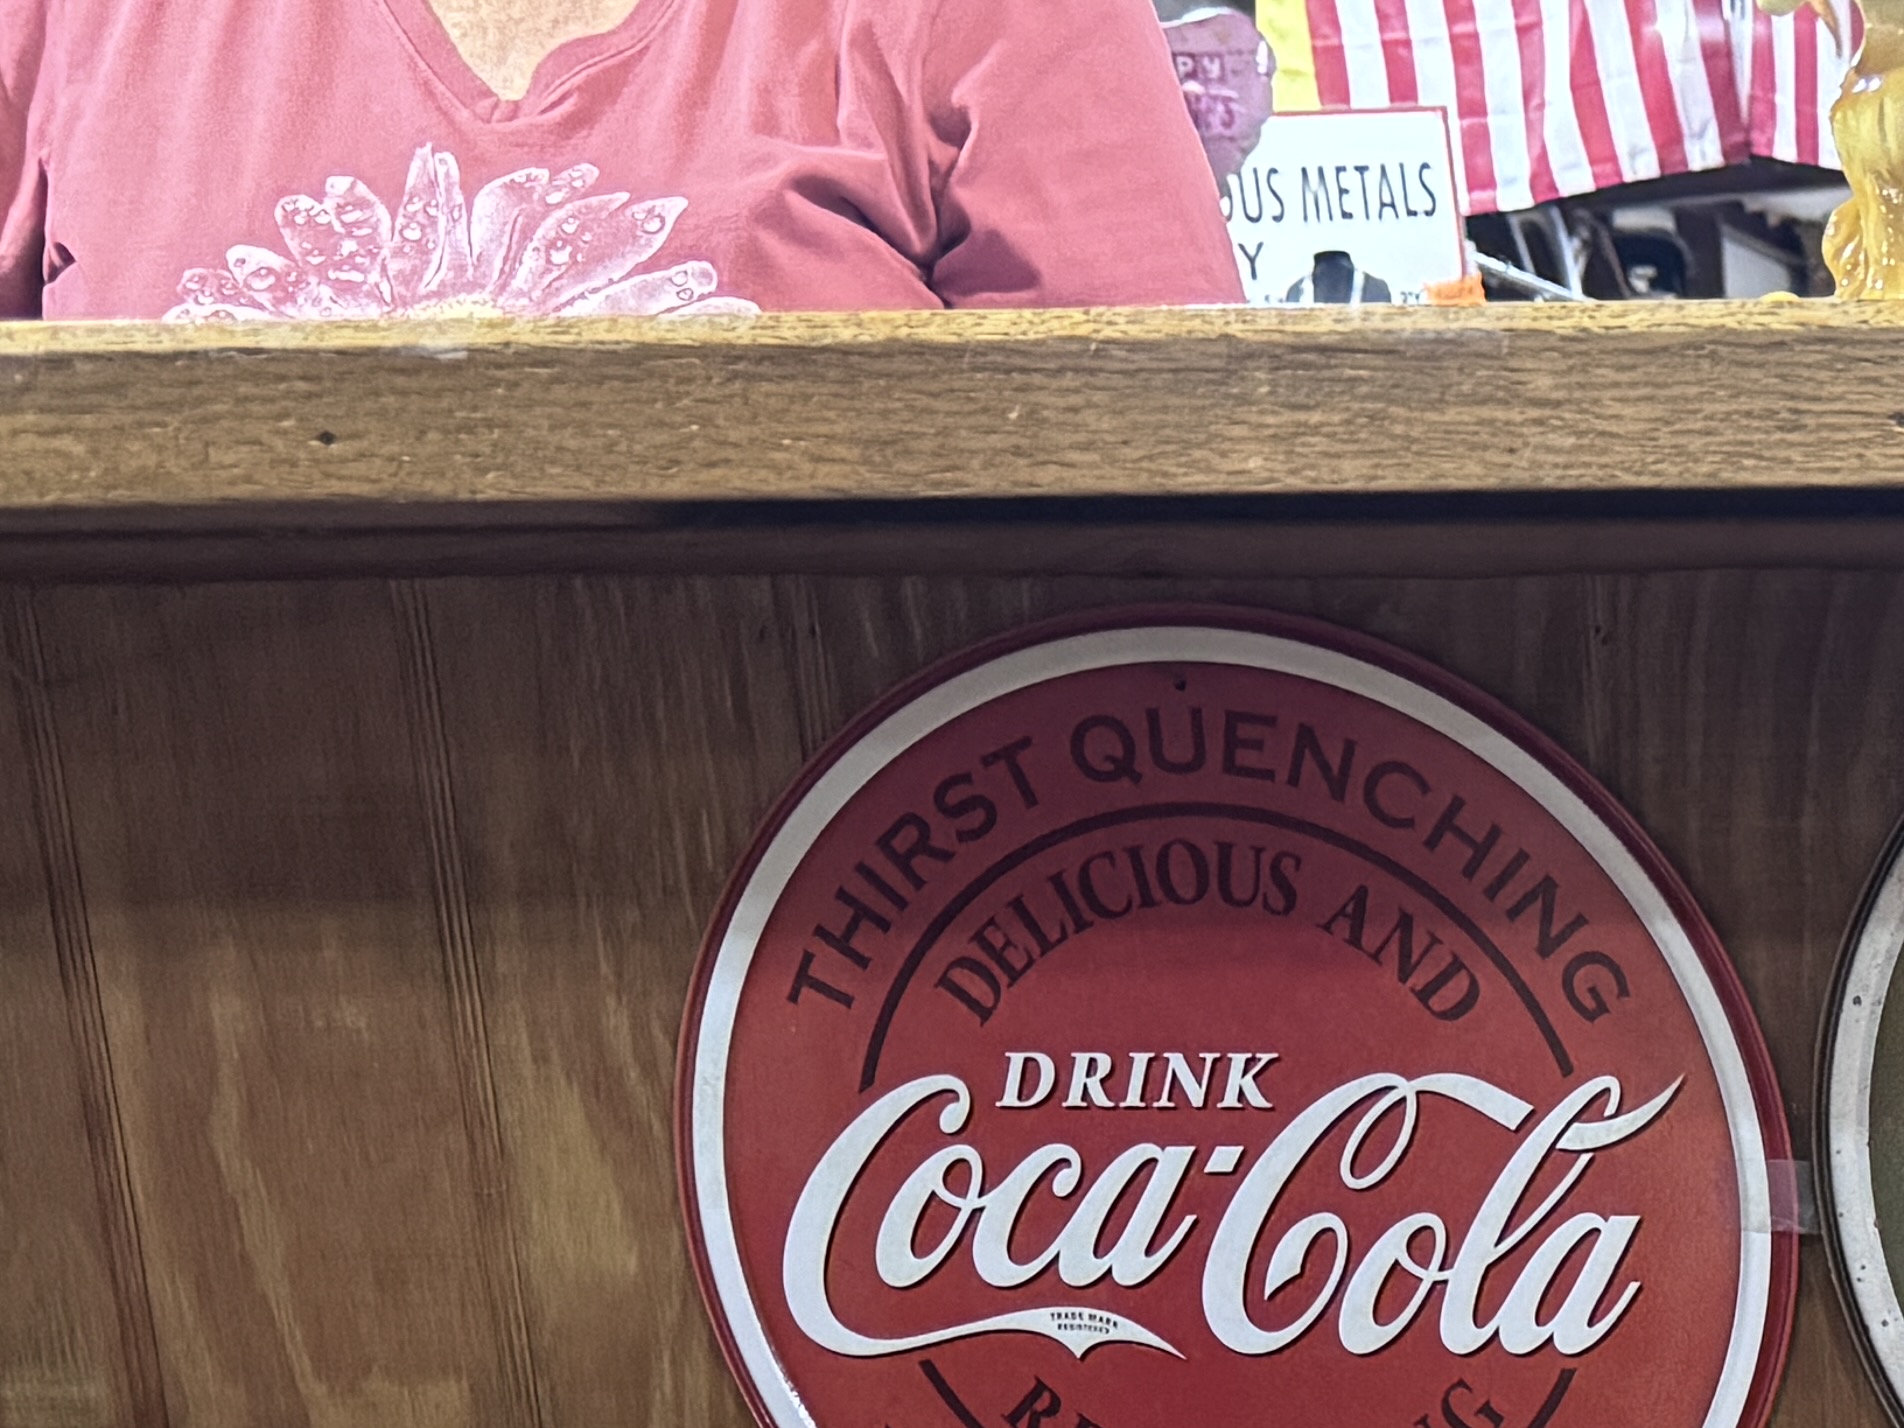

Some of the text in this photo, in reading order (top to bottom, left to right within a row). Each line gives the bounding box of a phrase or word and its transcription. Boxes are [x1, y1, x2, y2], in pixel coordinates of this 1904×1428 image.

[1302, 162, 1437, 222] METALS
[785, 707, 1633, 1023] THIRST QUENCHING
[934, 836, 1481, 1023] DELICIOUS AND
[996, 1051, 1278, 1110] DRINK
[783, 1072, 1686, 1361] Coca-Cola
